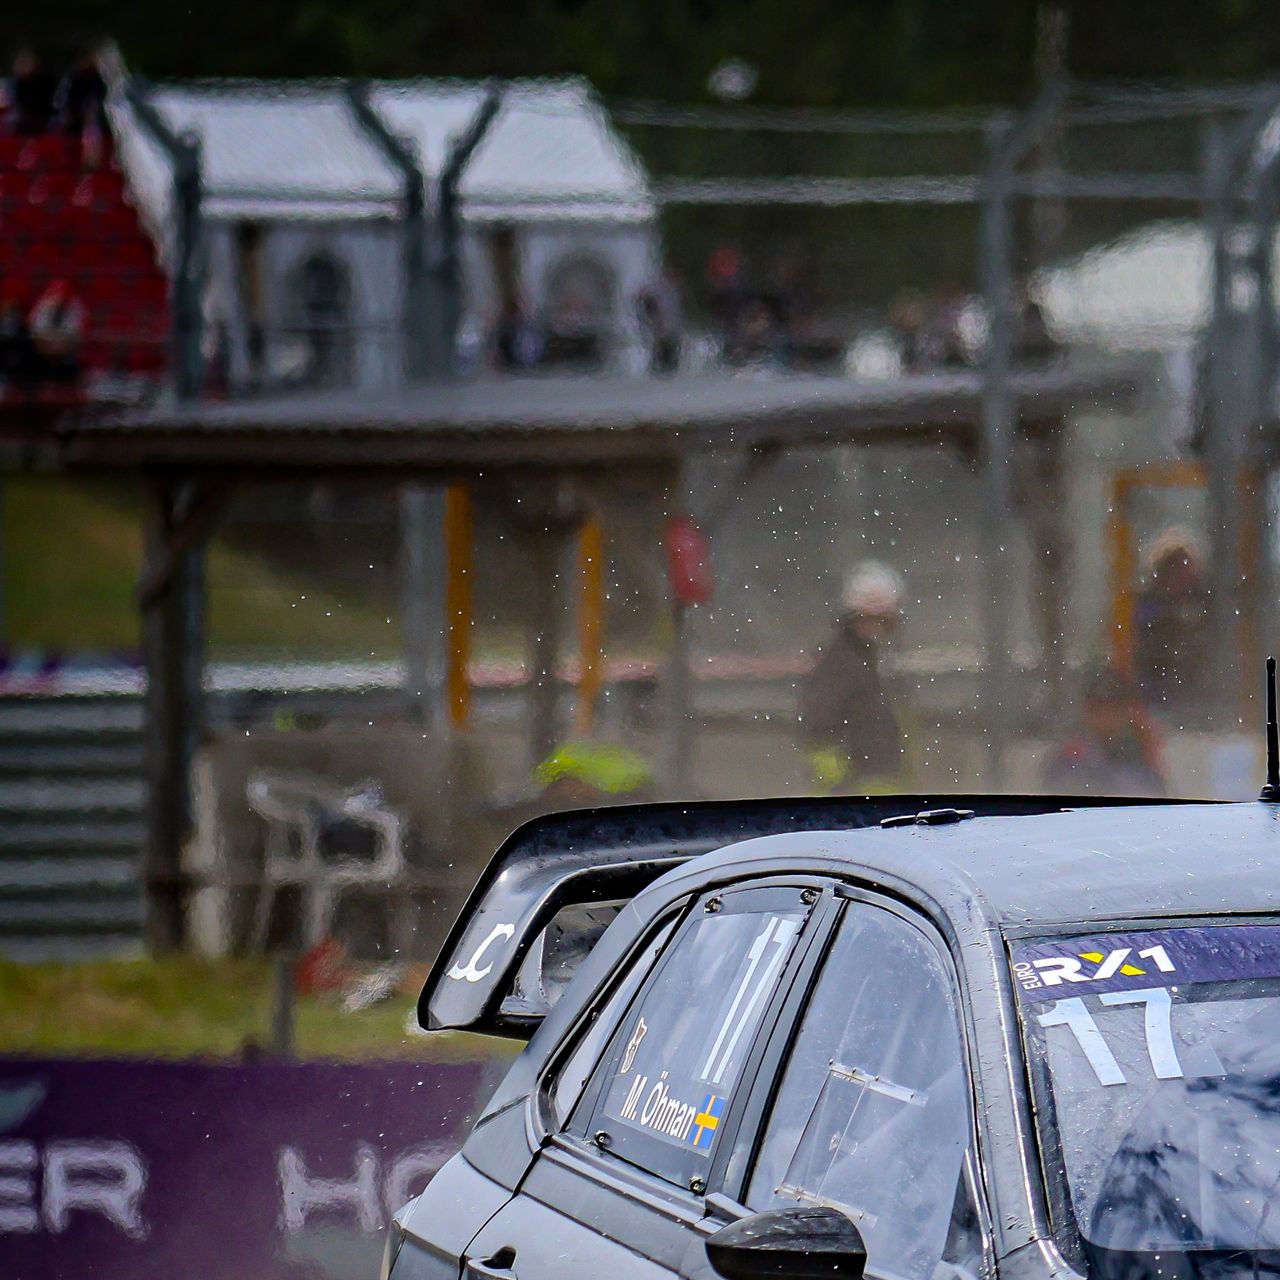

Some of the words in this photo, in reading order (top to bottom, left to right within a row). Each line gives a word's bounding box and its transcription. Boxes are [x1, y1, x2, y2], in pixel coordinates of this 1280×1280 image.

[1012, 962, 1043, 990] EURO
[1032, 944, 1177, 987] RX1
[1039, 986, 1183, 1086] 17
[620, 1073, 648, 1121] M.
[640, 1070, 697, 1141] Öhman
